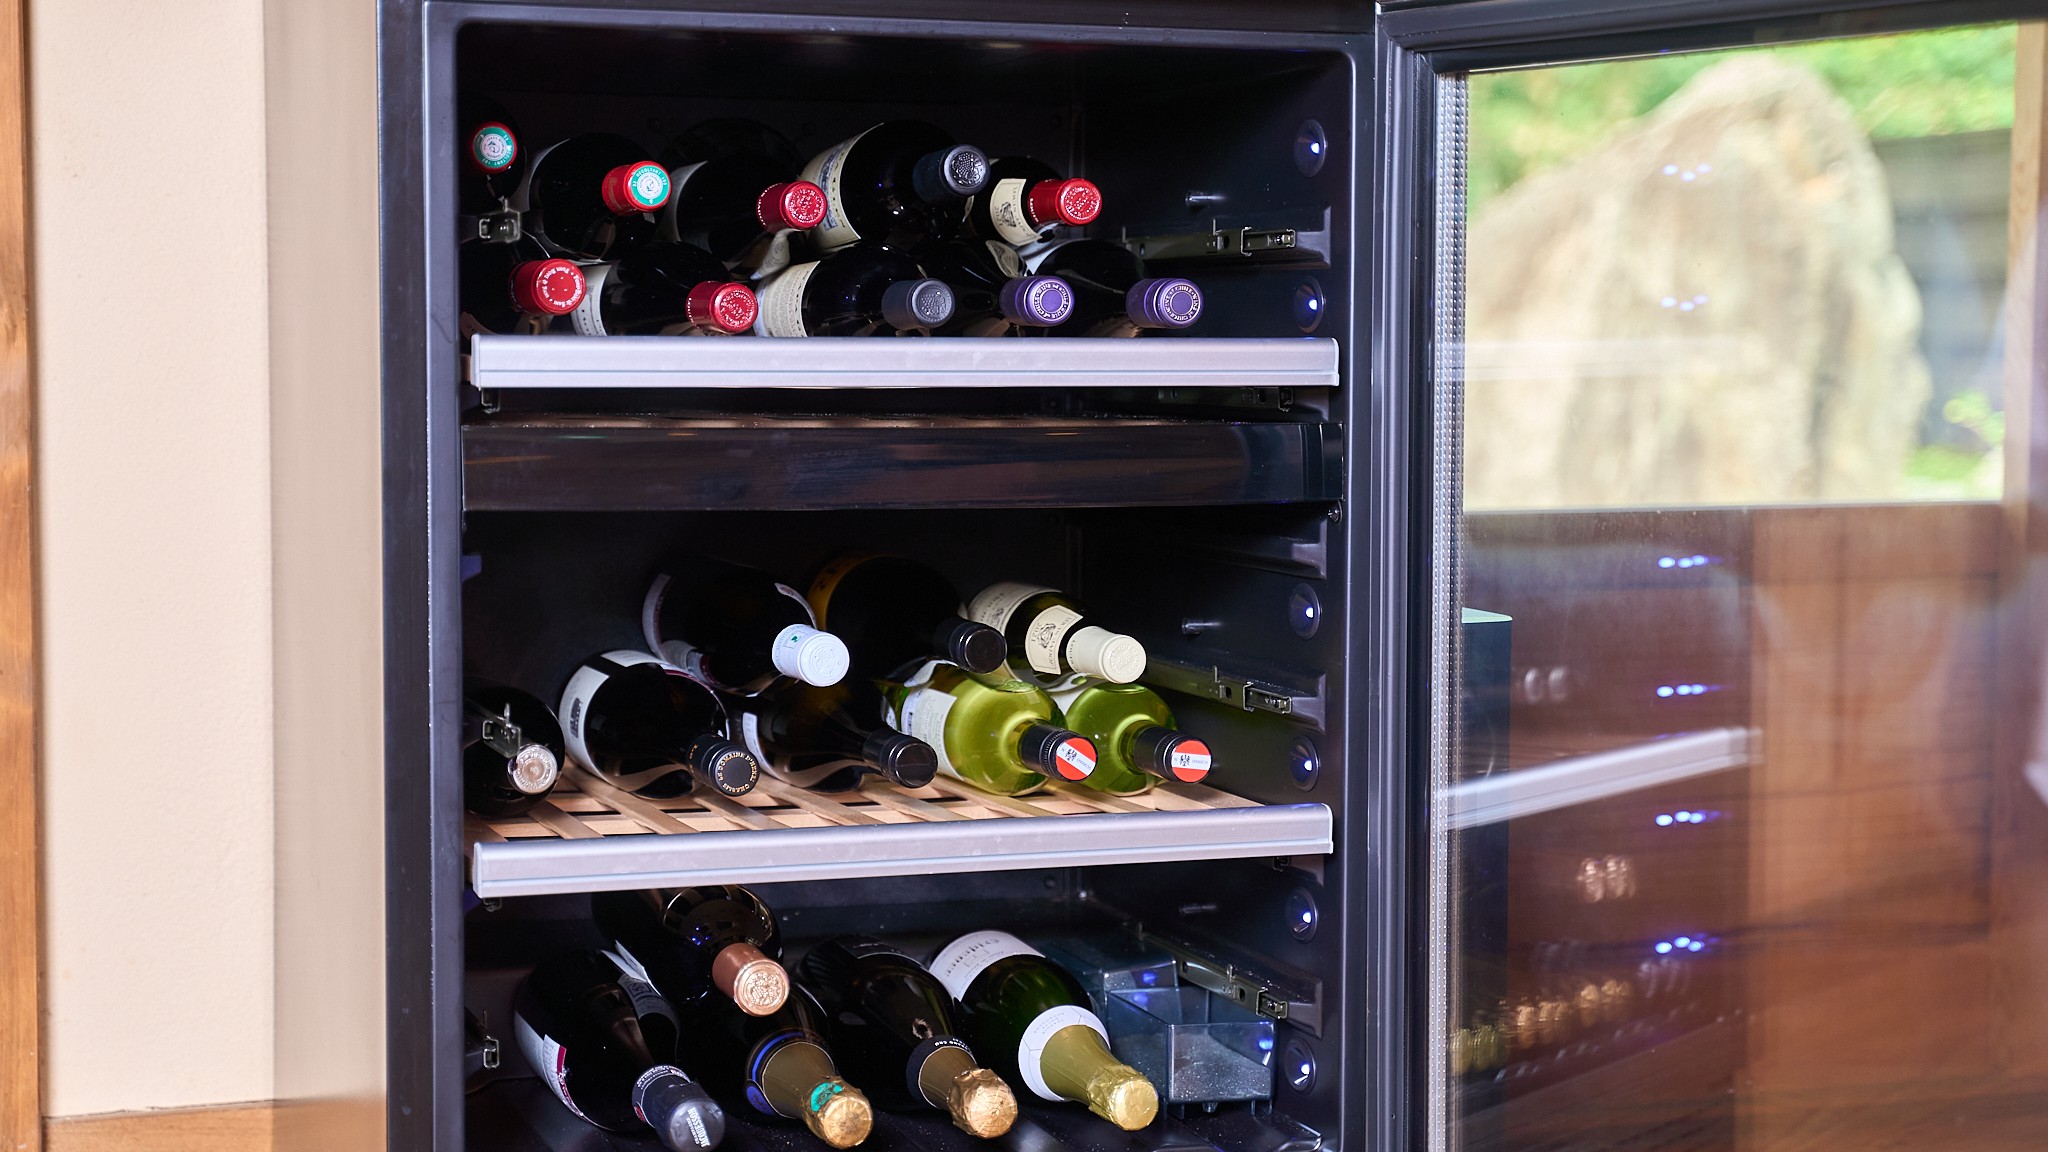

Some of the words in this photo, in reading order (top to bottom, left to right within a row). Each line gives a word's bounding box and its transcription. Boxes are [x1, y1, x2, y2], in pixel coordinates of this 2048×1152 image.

[1031, 622, 1042, 643] 2021
[718, 752, 746, 772] DOMAINE
[722, 783, 750, 793] CHABLIS
[686, 1116, 700, 1145] CHAMPAGNE
[687, 1106, 710, 1148] JACQUESSON
